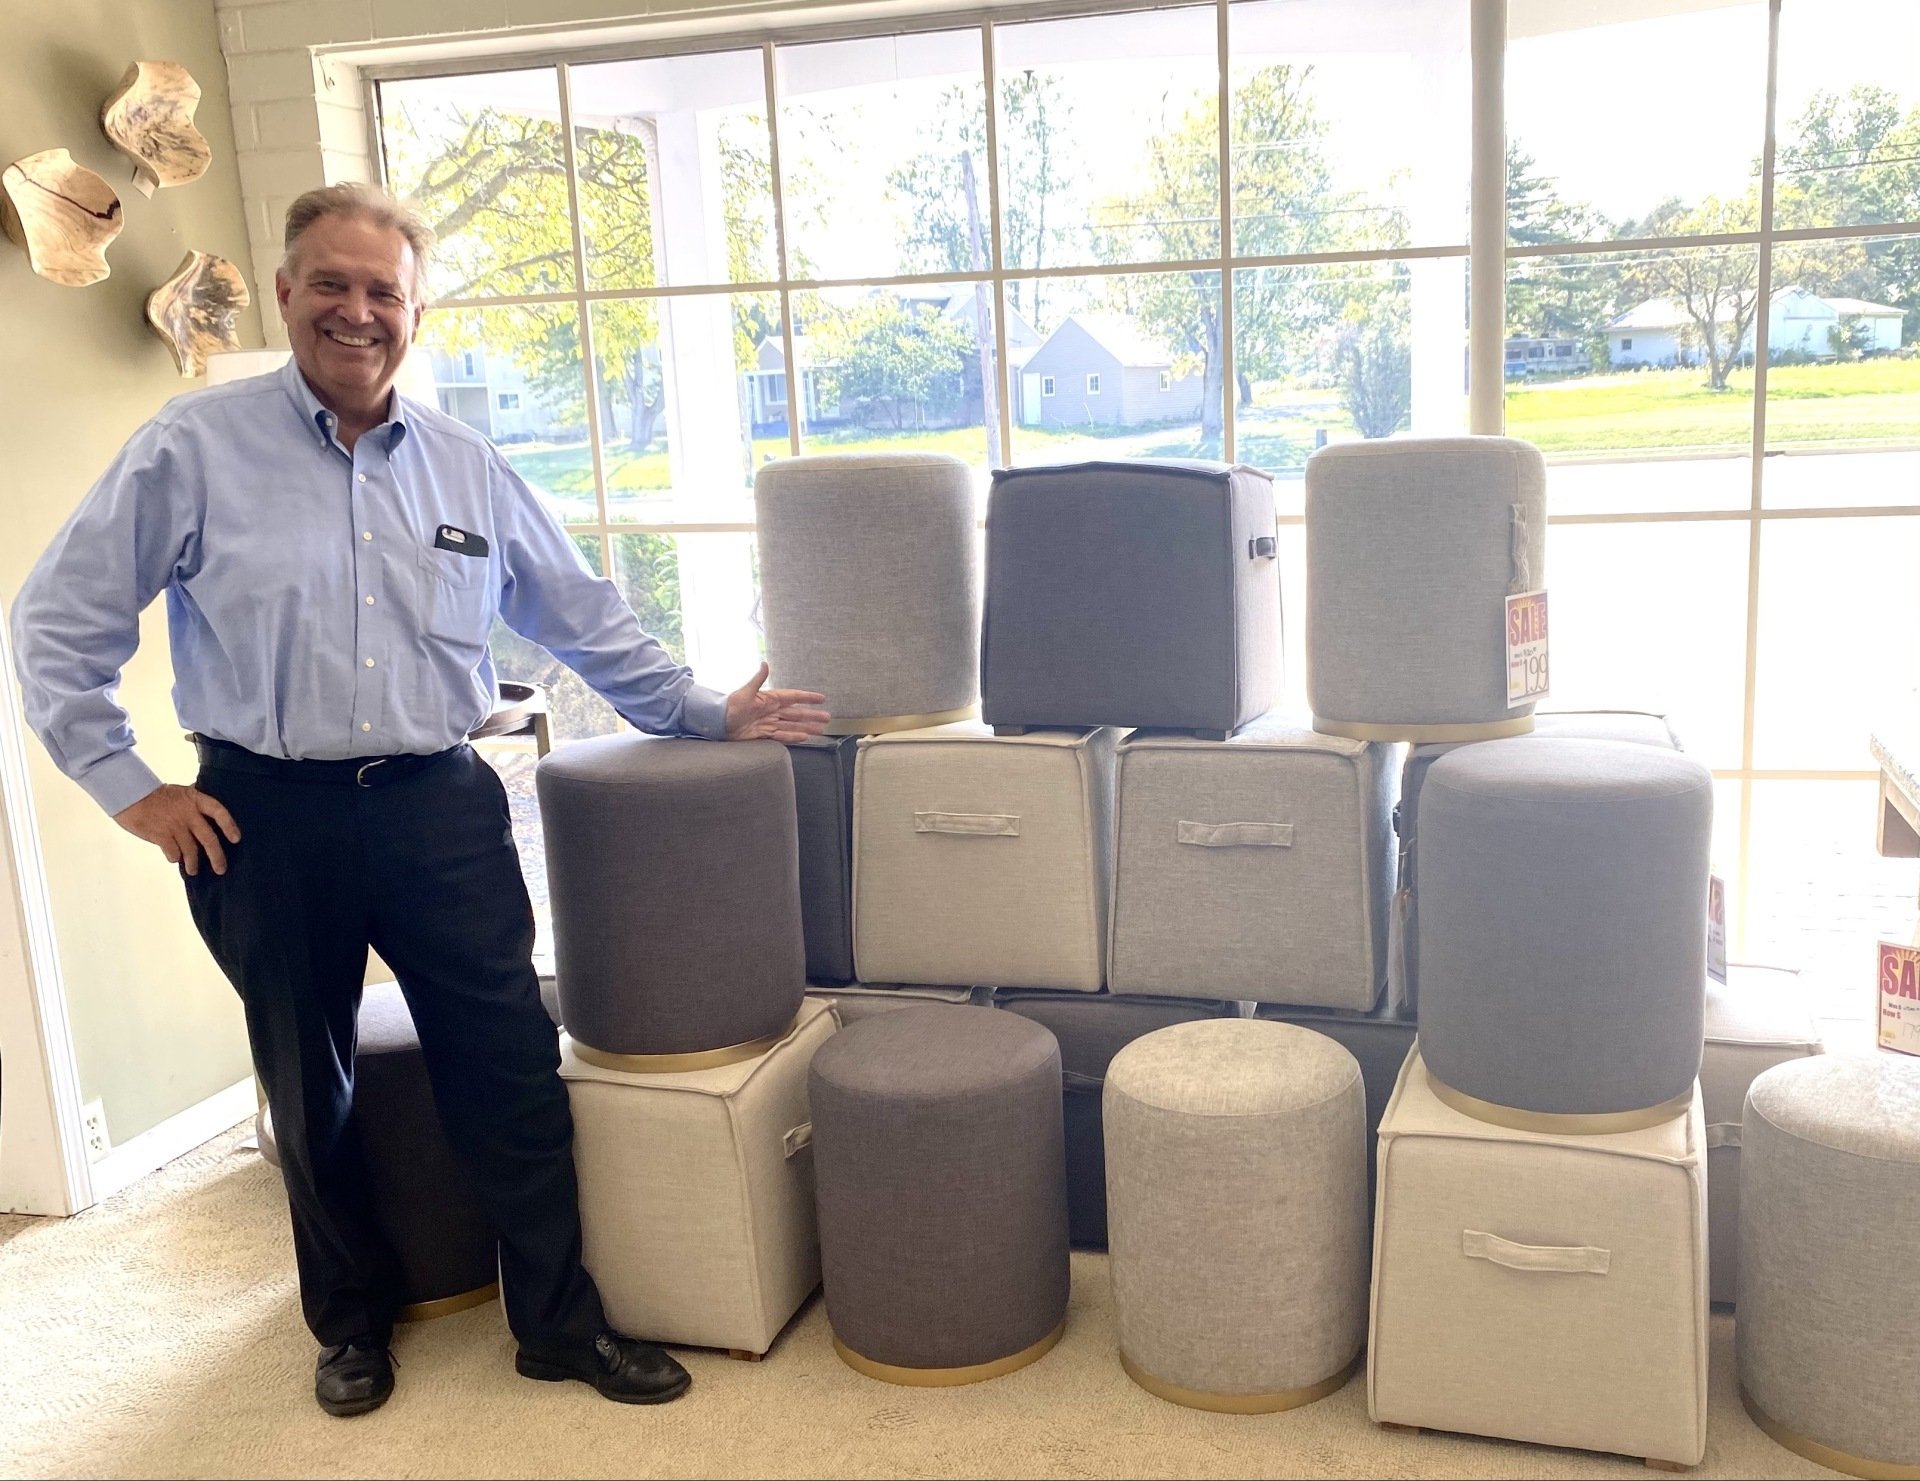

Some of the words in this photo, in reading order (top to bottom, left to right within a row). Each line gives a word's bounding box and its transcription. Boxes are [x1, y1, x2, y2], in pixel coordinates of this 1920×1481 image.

[1510, 602, 1546, 646] SALE
[1523, 653, 1548, 696] 199
[1883, 956, 1920, 1001] SA
